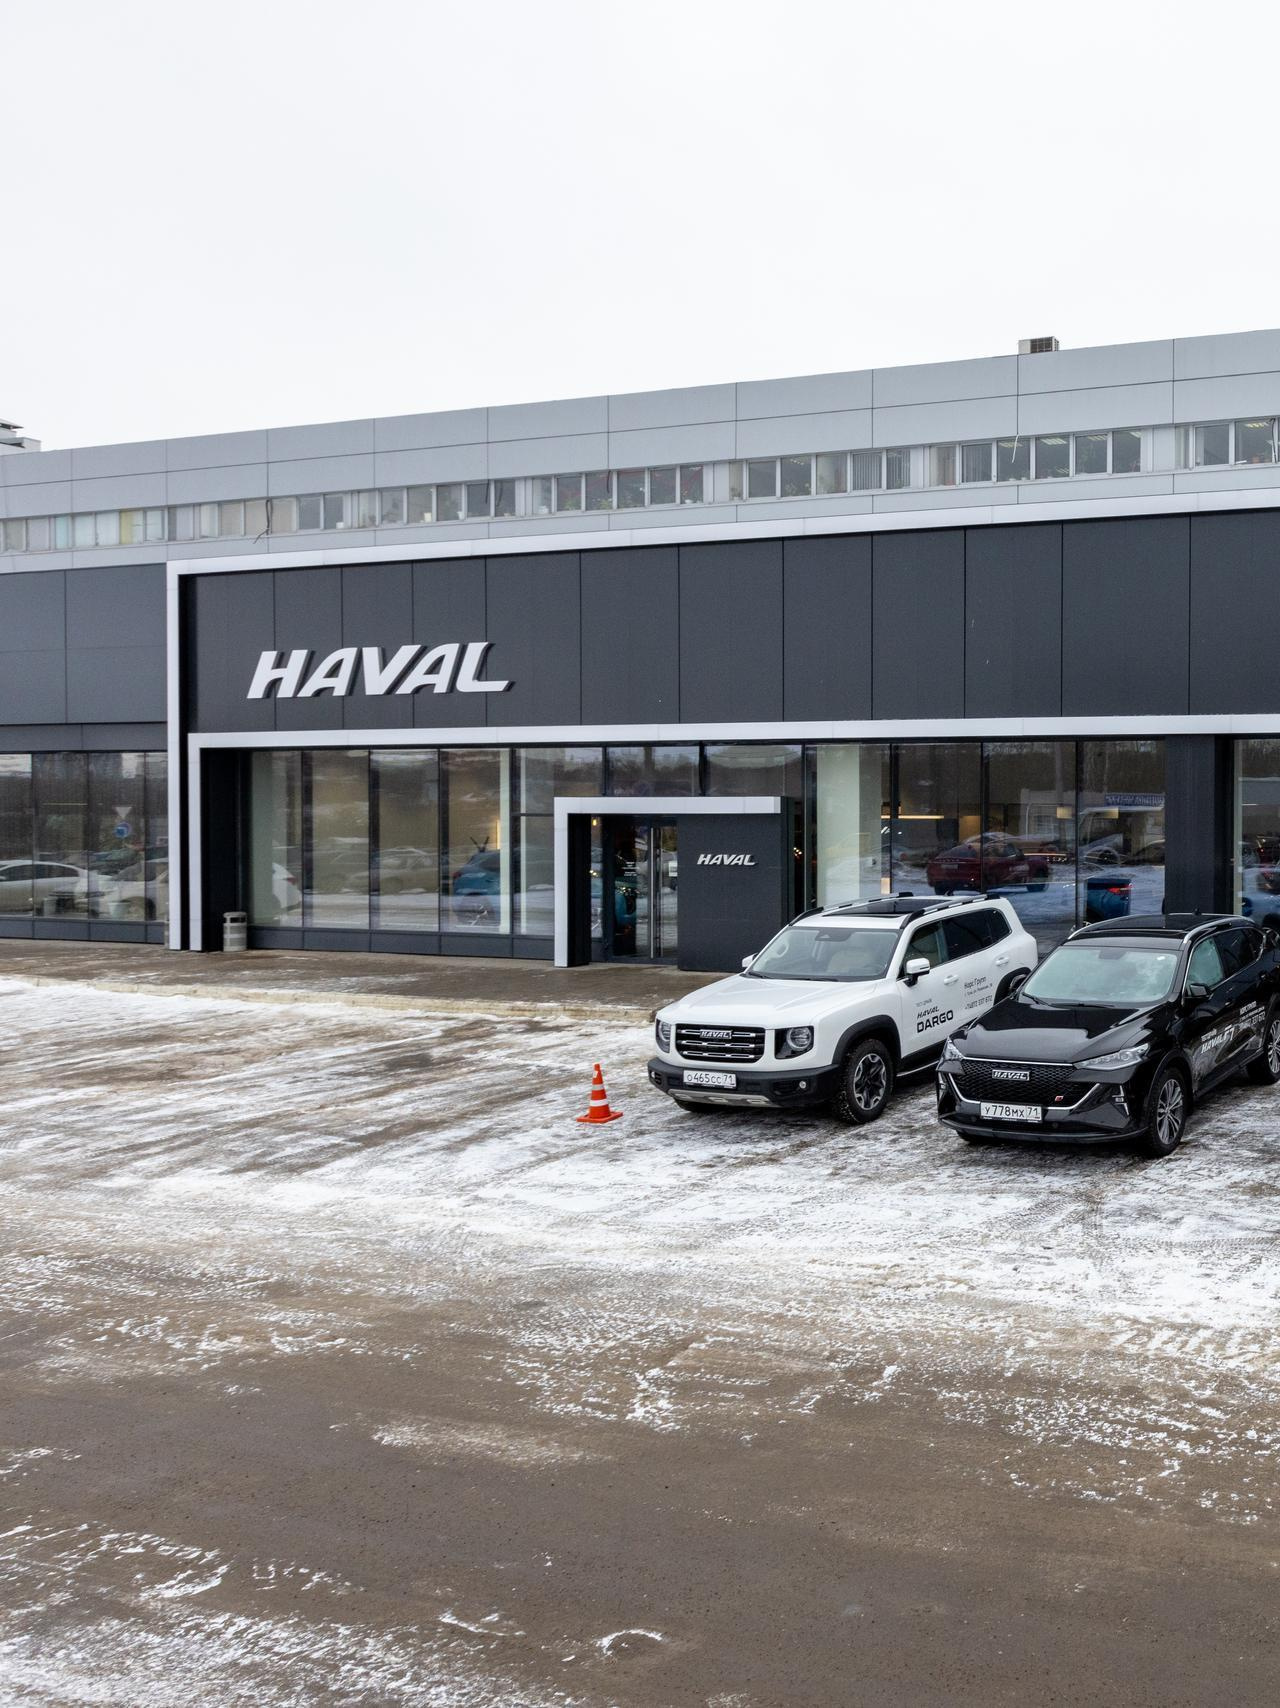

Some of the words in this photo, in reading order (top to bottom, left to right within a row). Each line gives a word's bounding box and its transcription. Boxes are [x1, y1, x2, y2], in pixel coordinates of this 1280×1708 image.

[247, 641, 511, 699] HAVAL
[697, 853, 757, 866] HAVAL
[917, 1006, 940, 1018] HAVAL
[916, 1009, 954, 1033] DARGO
[701, 1030, 730, 1038] HAVAL
[994, 1071, 1027, 1079] HAVAL
